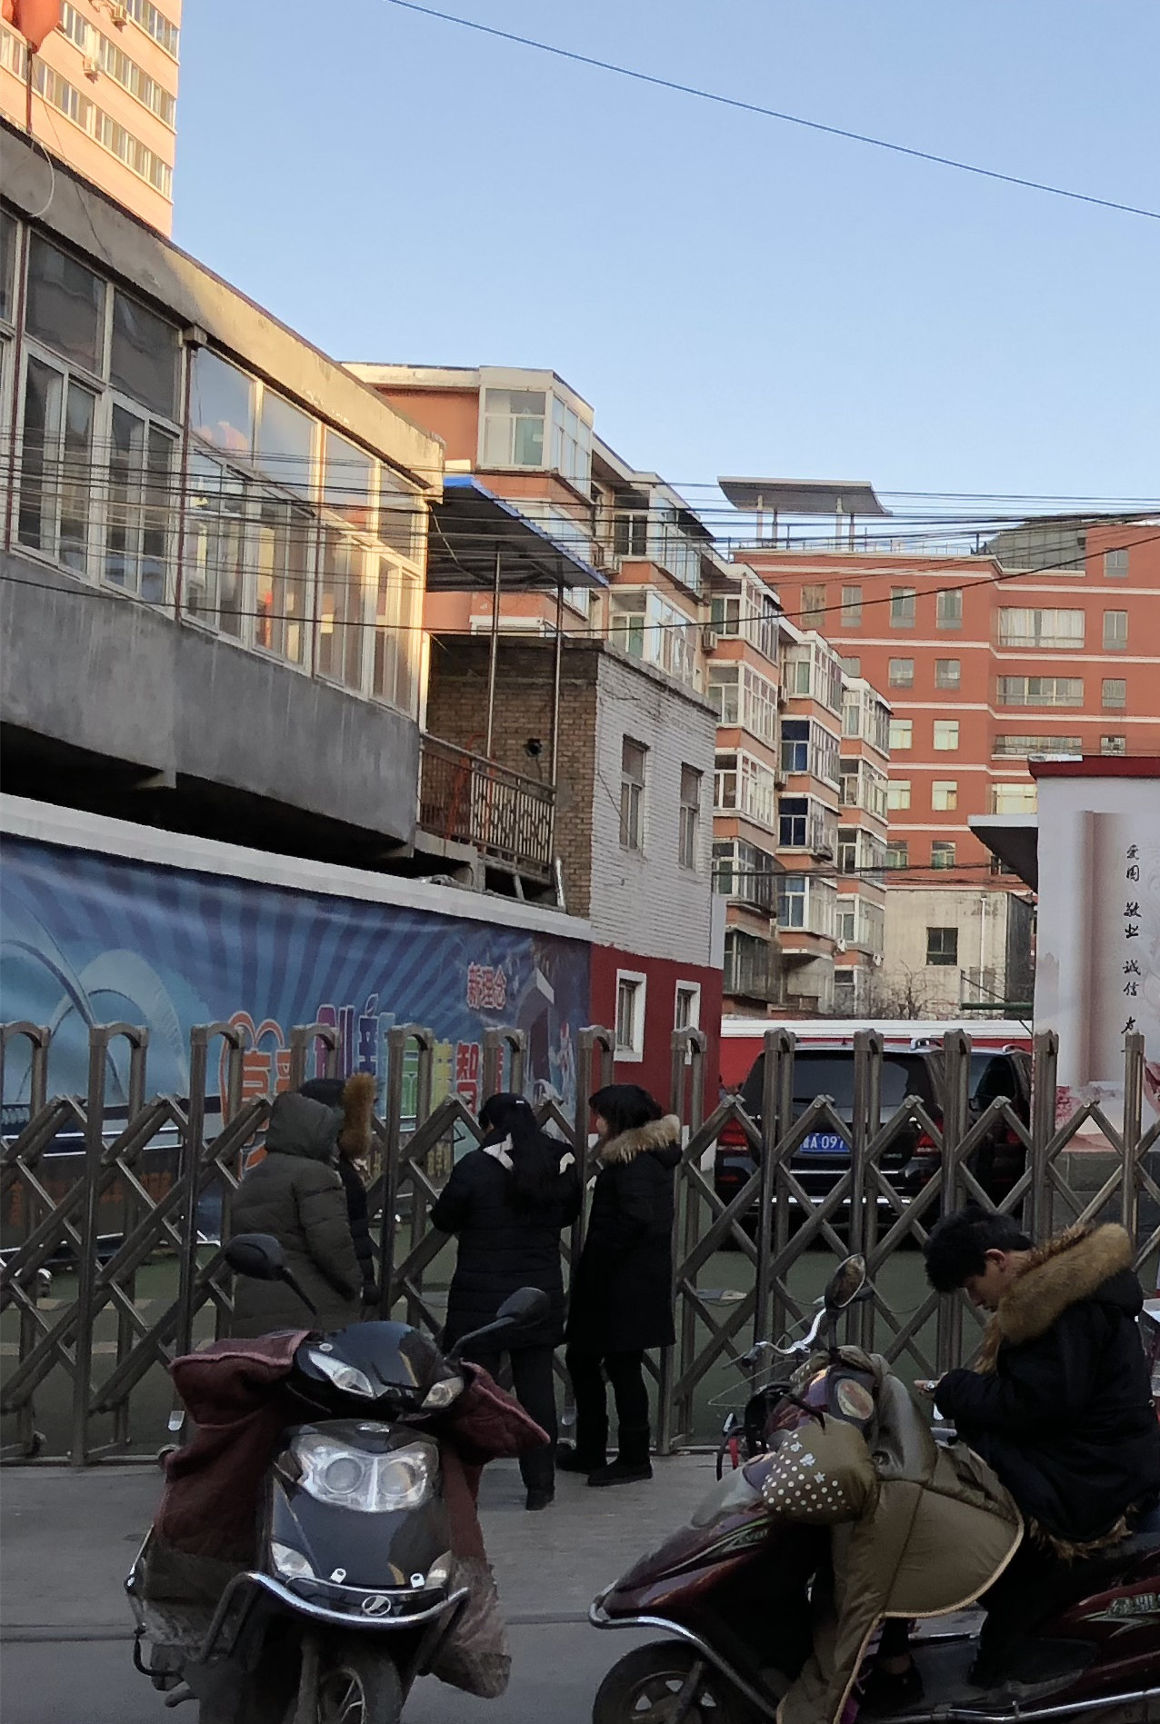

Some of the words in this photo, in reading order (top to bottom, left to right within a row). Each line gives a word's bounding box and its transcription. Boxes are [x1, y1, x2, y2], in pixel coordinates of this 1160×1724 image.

[1123, 901, 1142, 939] 敬业
[1122, 960, 1141, 997] 诚信
[1120, 1016, 1137, 1053] 友
